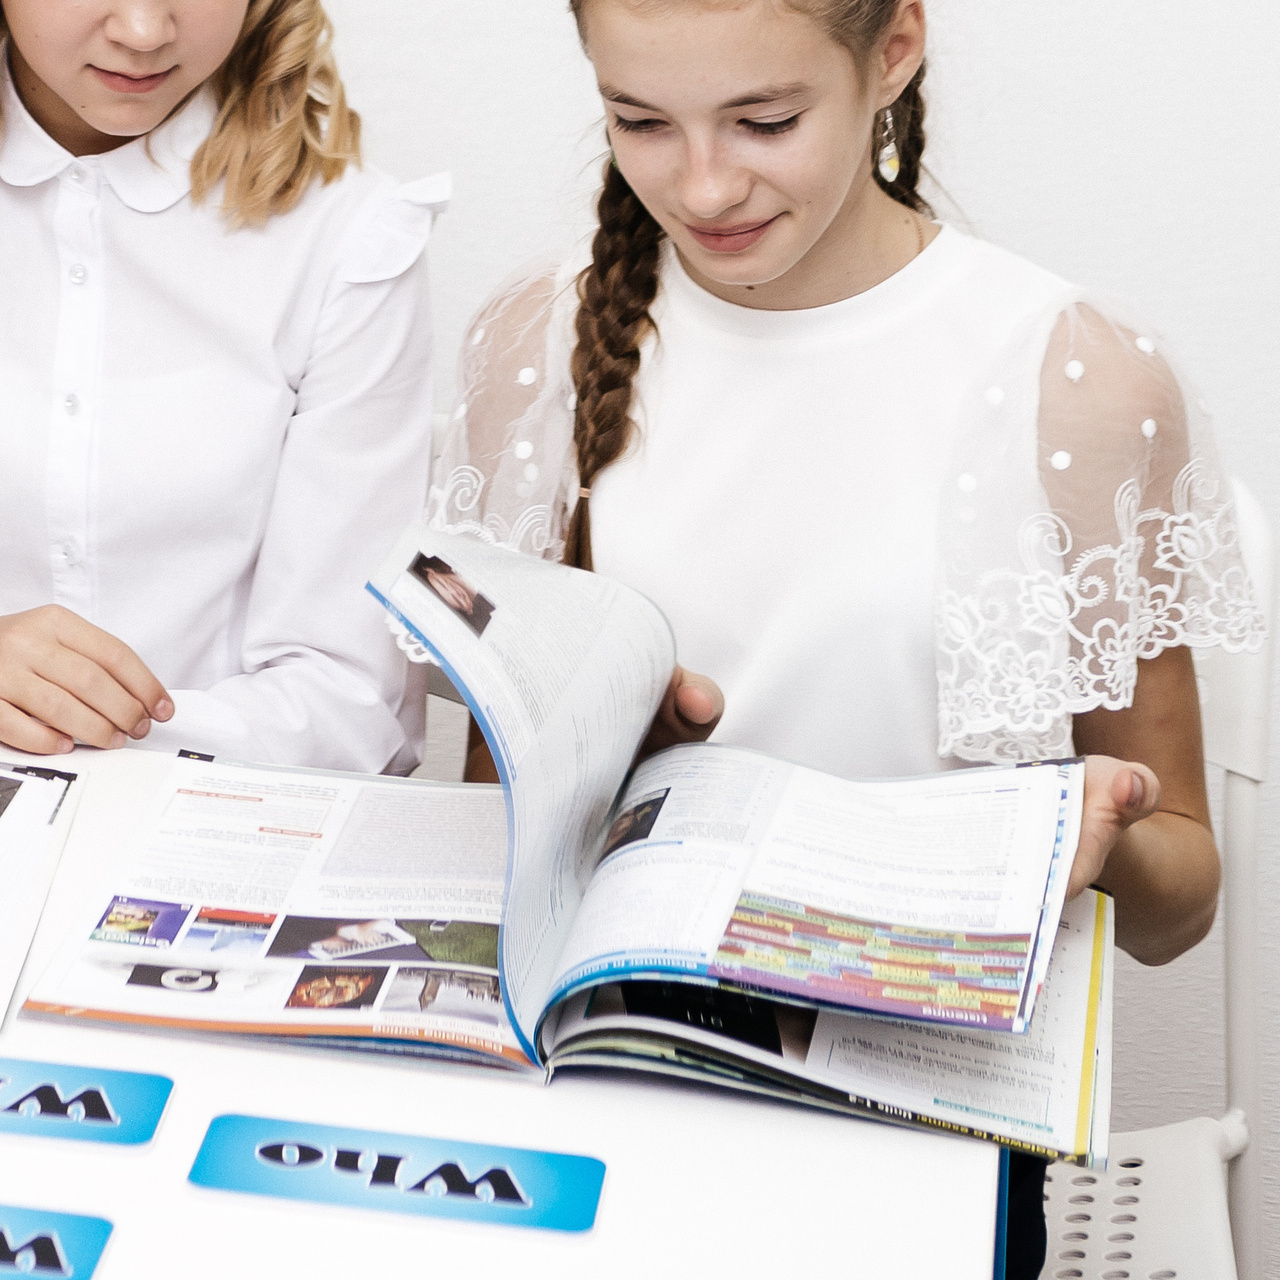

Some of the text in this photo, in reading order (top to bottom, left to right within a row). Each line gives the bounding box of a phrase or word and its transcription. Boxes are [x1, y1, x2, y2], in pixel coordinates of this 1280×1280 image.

[613, 959, 625, 968] in
[628, 958, 697, 969] Grammar
[922, 1006, 987, 1025] Listening
[877, 1103, 912, 1121] Units
[973, 1129, 988, 1140] to
[992, 1133, 1058, 1158] Gateway
[255, 1141, 533, 1207] Who
